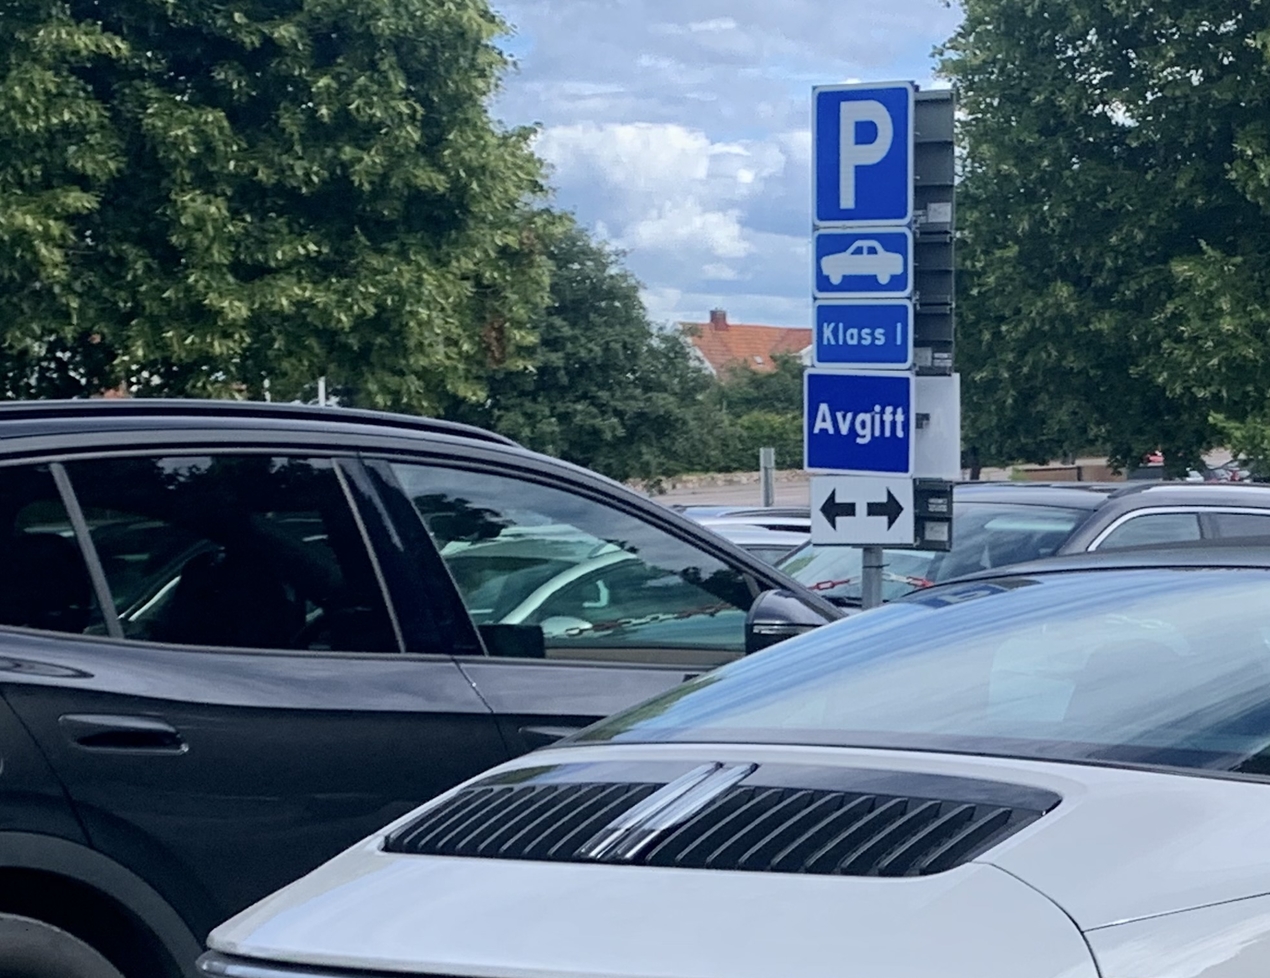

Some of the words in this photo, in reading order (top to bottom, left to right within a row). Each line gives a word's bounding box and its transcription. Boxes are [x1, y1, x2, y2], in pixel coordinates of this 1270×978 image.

[839, 99, 894, 210] P
[822, 321, 886, 346] Klass
[813, 402, 906, 445] Avgift
